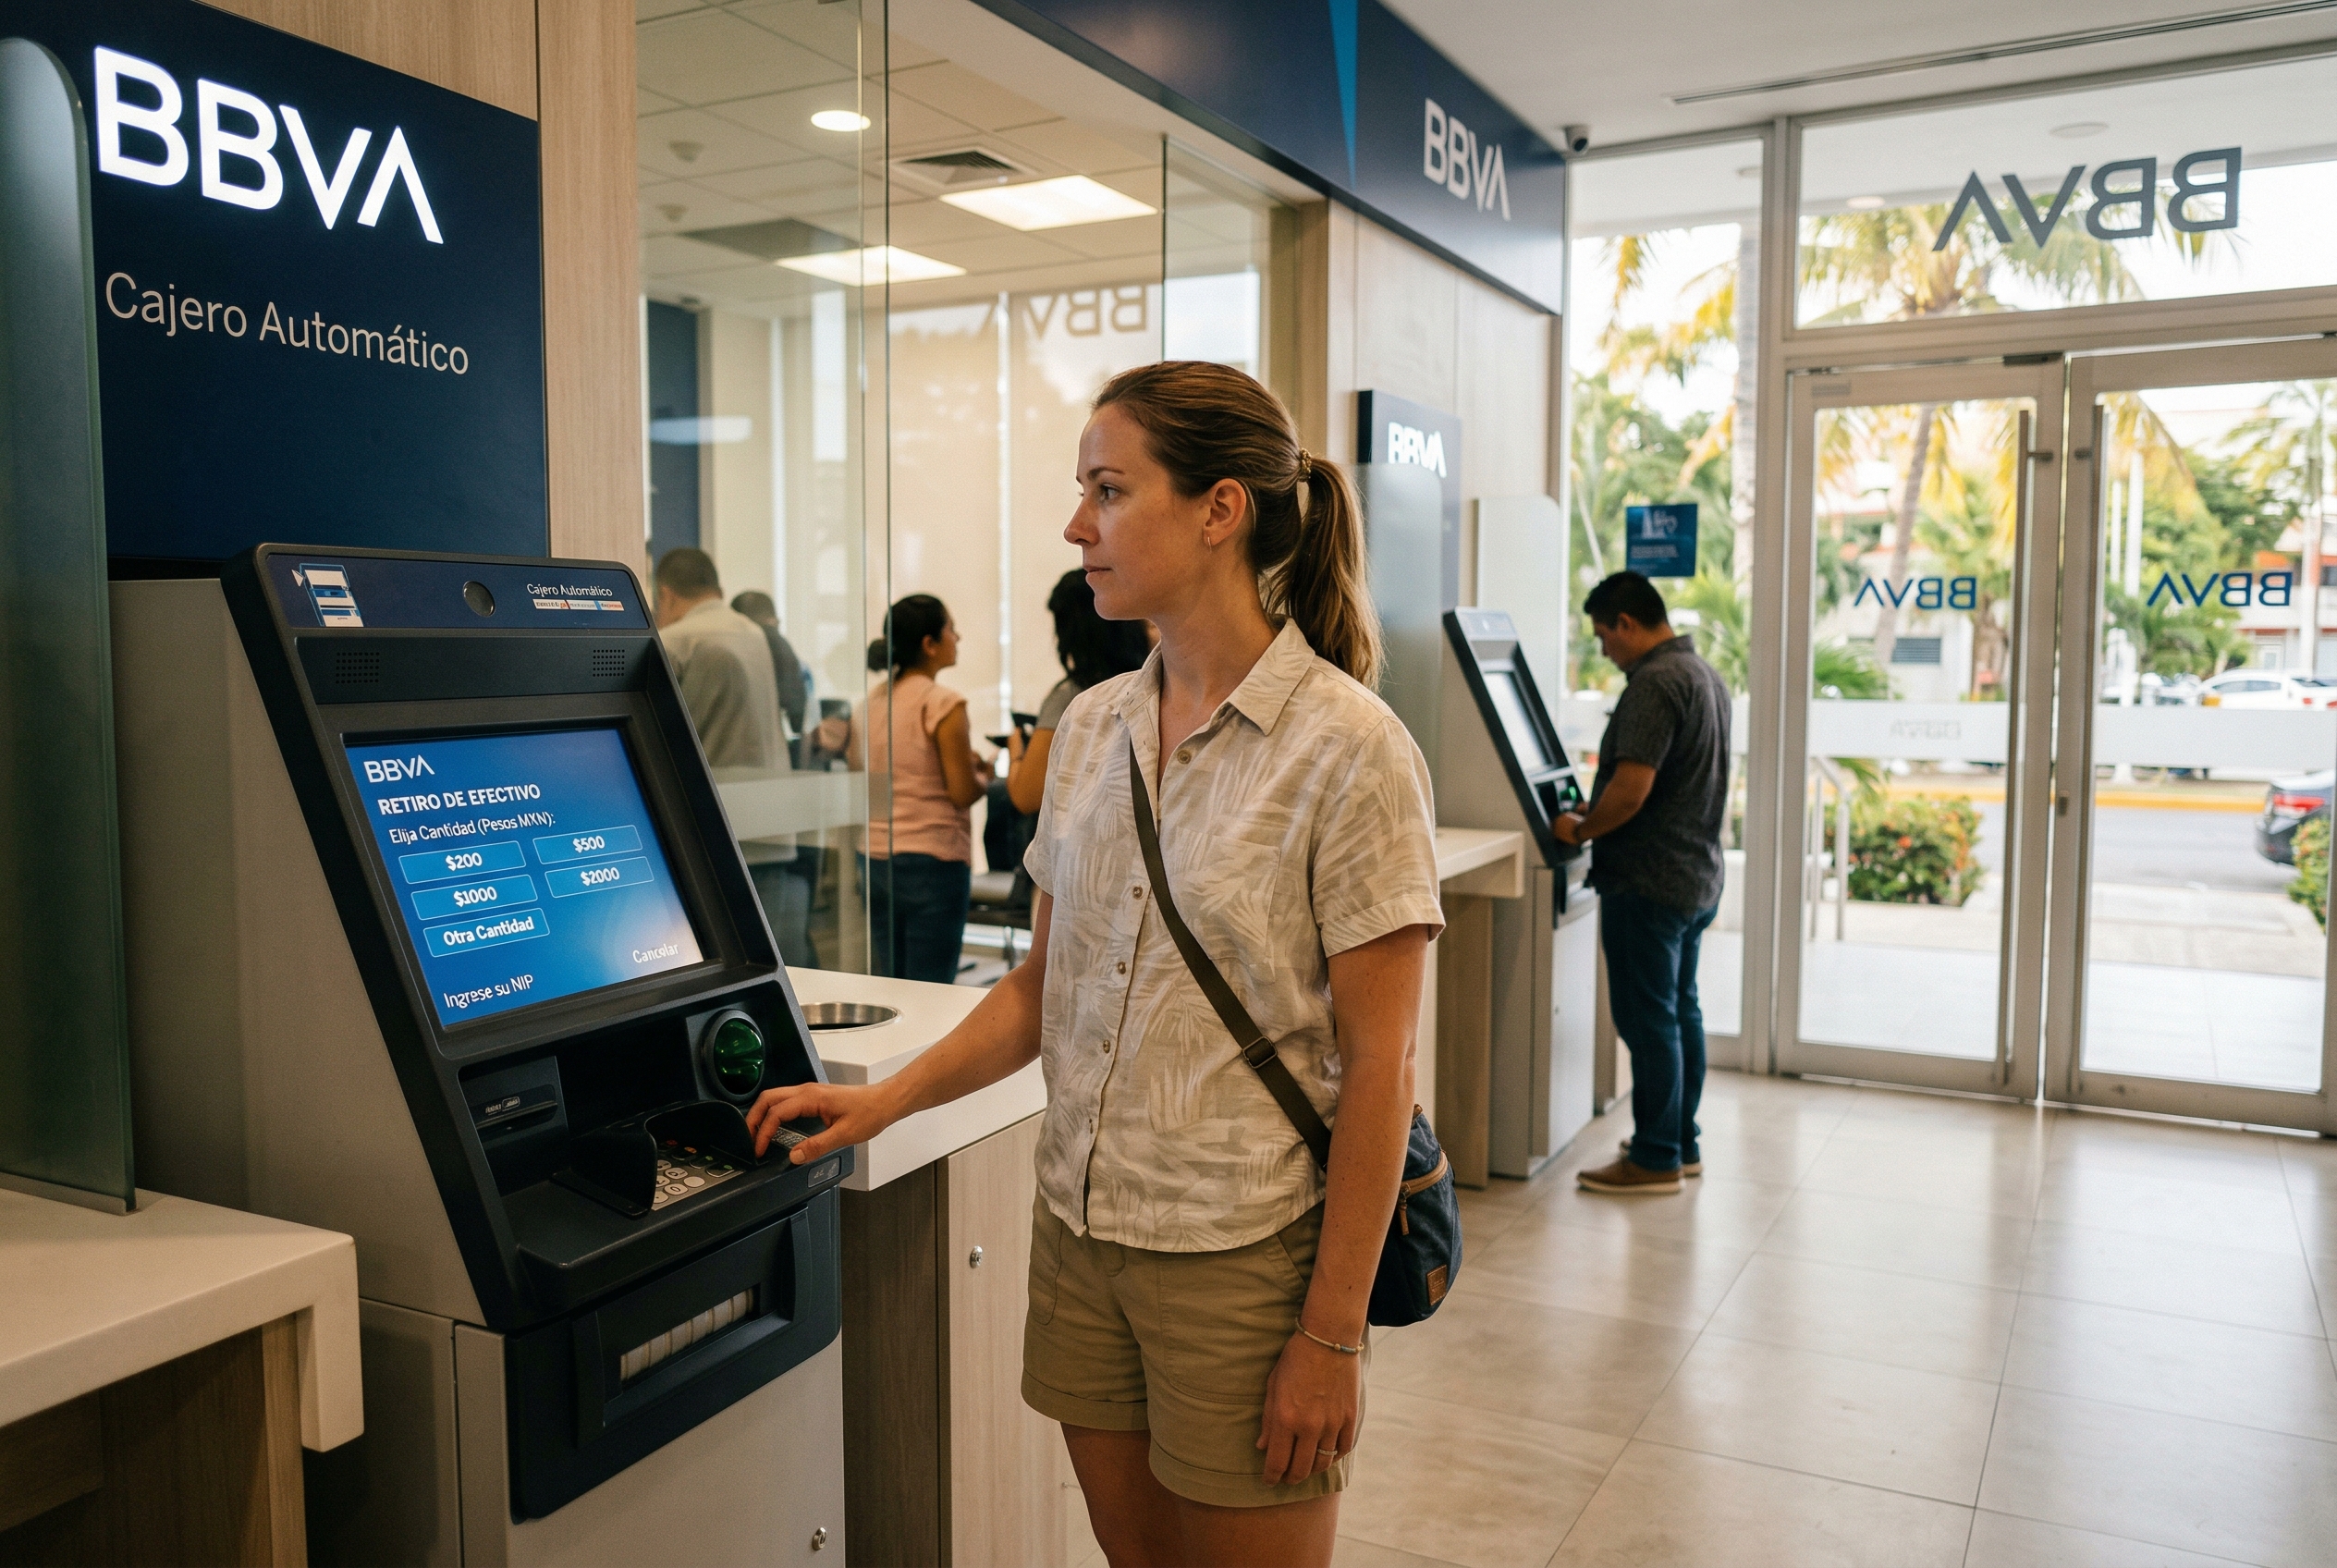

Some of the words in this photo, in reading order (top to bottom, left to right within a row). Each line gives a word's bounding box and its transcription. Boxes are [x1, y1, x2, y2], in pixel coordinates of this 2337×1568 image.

[93, 45, 445, 245] BBVA
[1425, 97, 1511, 222] BBVA
[105, 272, 248, 337] Cajero
[259, 301, 469, 374] Automático
[526, 583, 559, 598] Cajero
[363, 754, 435, 783] BBVA
[377, 793, 442, 815] RETIRO
[443, 790, 468, 809] DE
[467, 783, 542, 806] EFECTIVO
[388, 828, 419, 846] Elija
[418, 819, 477, 840] Cantidad
[477, 817, 519, 836] (Pesos
[517, 811, 557, 827] MXN):
[572, 835, 606, 853] $500
[445, 851, 483, 872] $200
[580, 866, 620, 888] $2000
[453, 886, 498, 908] $1000
[443, 929, 476, 947] Otra
[477, 916, 535, 940] Cantidad
[444, 986, 494, 1010] Ingrese
[495, 983, 511, 997] su
[510, 974, 534, 993] NIP
